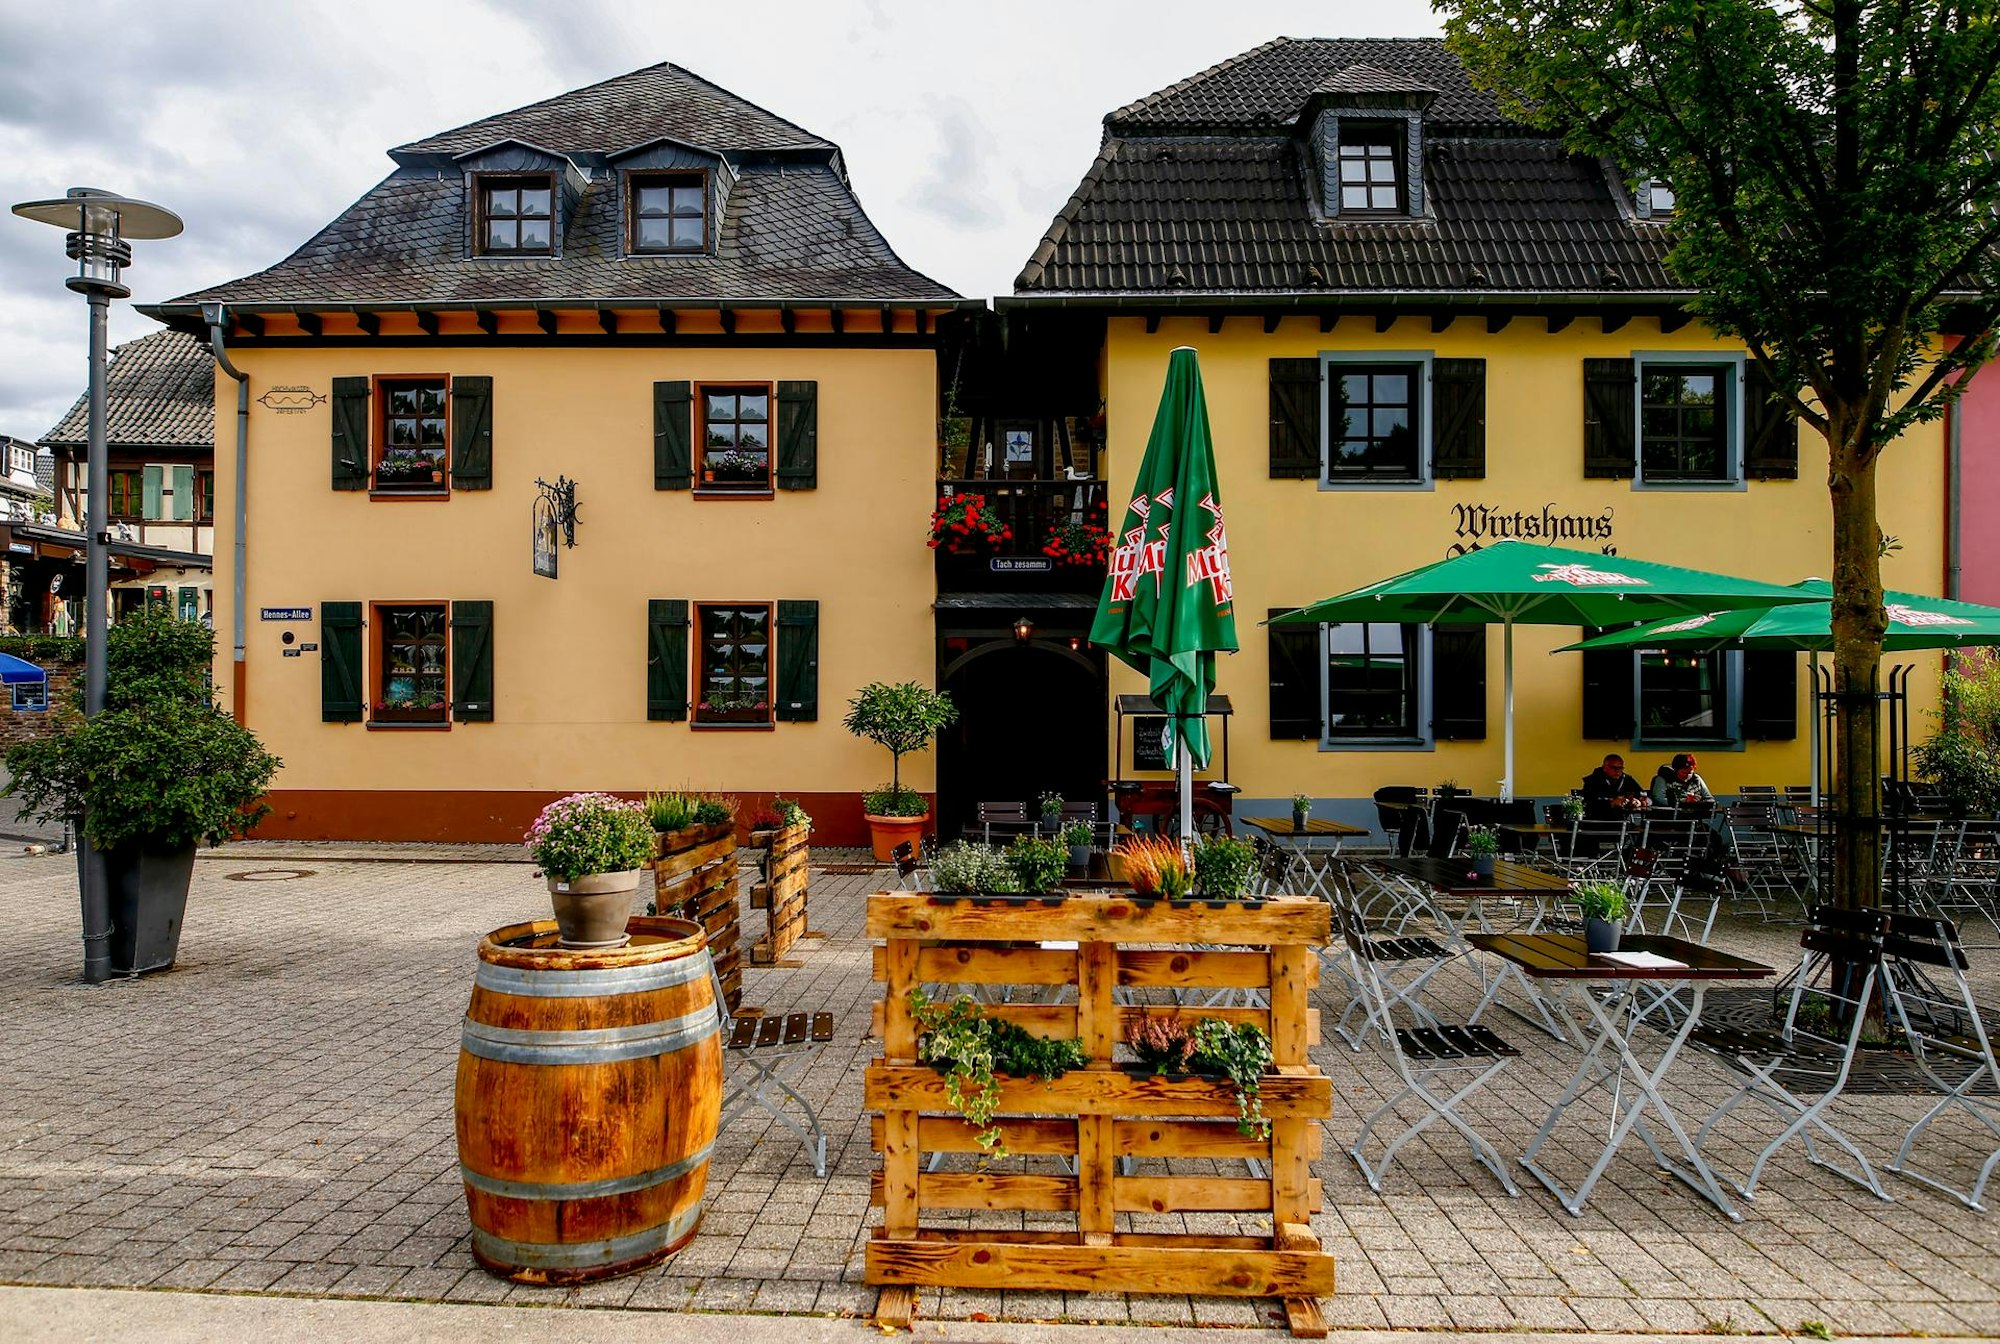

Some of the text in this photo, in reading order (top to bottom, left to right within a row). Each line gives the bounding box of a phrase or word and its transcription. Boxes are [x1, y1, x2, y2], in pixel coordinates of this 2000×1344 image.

[1451, 502, 1615, 547] Wirtshaus
[996, 559, 1047, 569] Tach zesamme
[263, 609, 310, 619] Hennes-Allee
